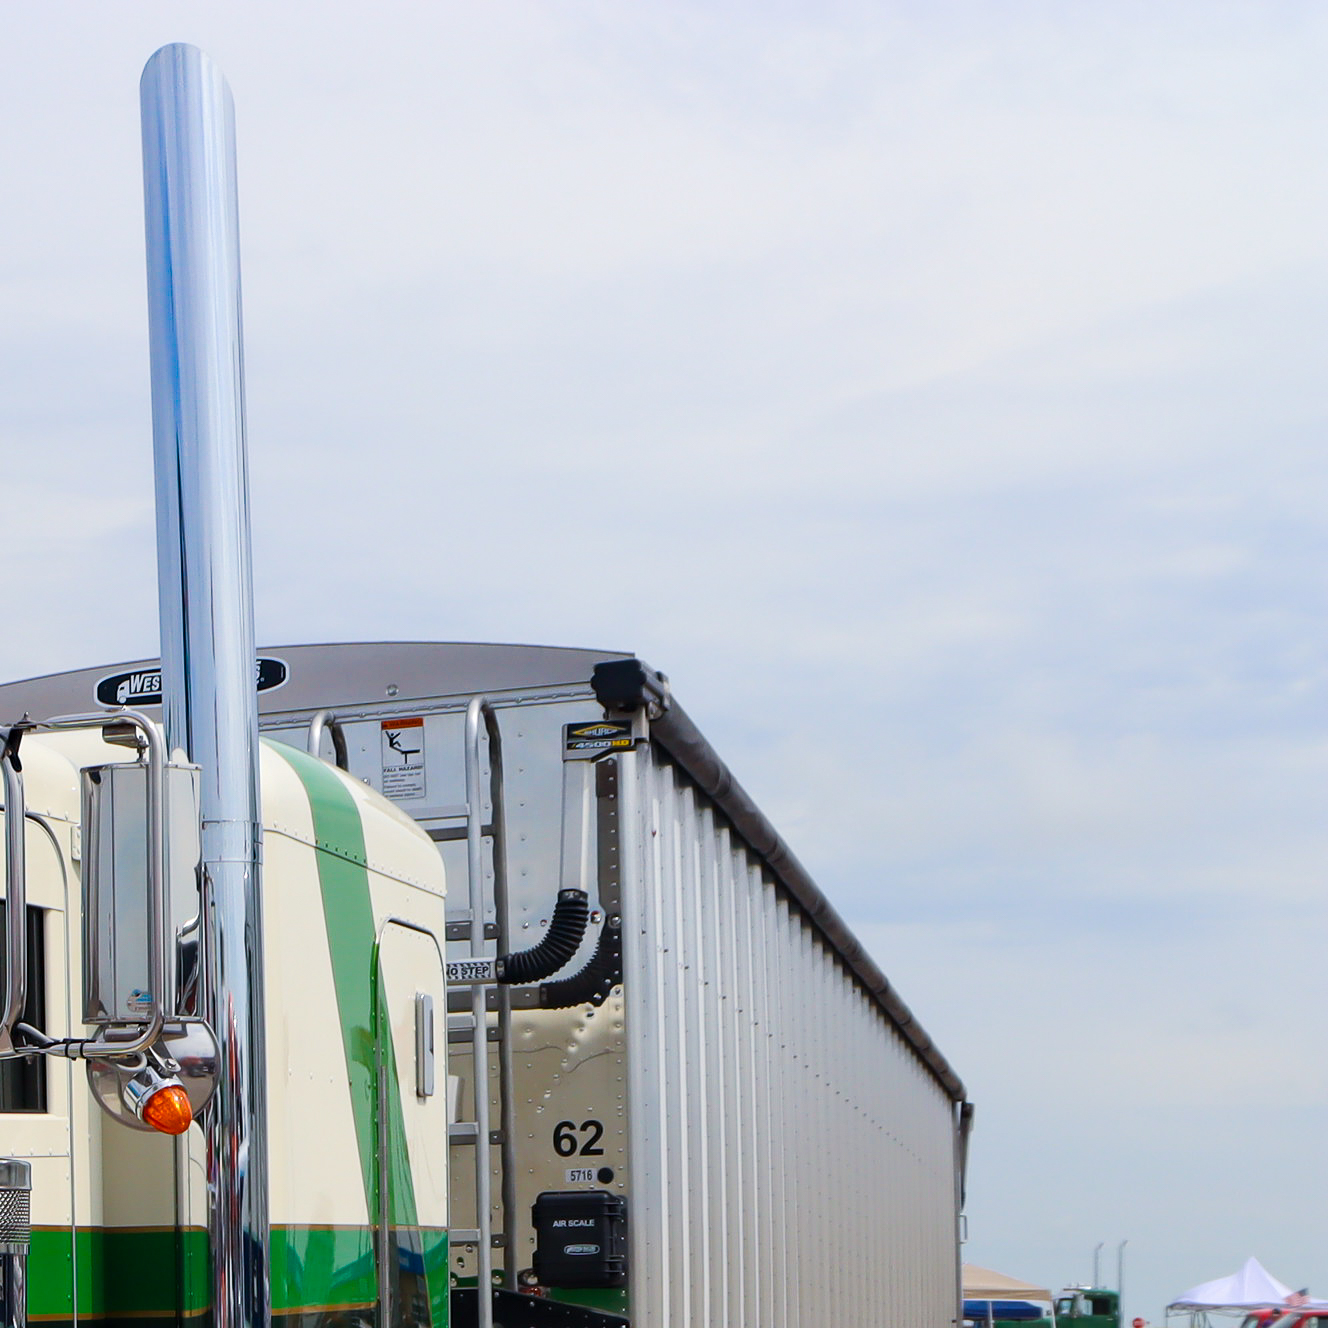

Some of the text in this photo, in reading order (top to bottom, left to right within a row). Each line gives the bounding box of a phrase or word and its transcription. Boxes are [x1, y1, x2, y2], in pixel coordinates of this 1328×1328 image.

[461, 966, 489, 976] STEP
[552, 1119, 605, 1158] 62
[570, 1169, 593, 1182] 5716
[552, 1218, 595, 1228] AIR SCALE
